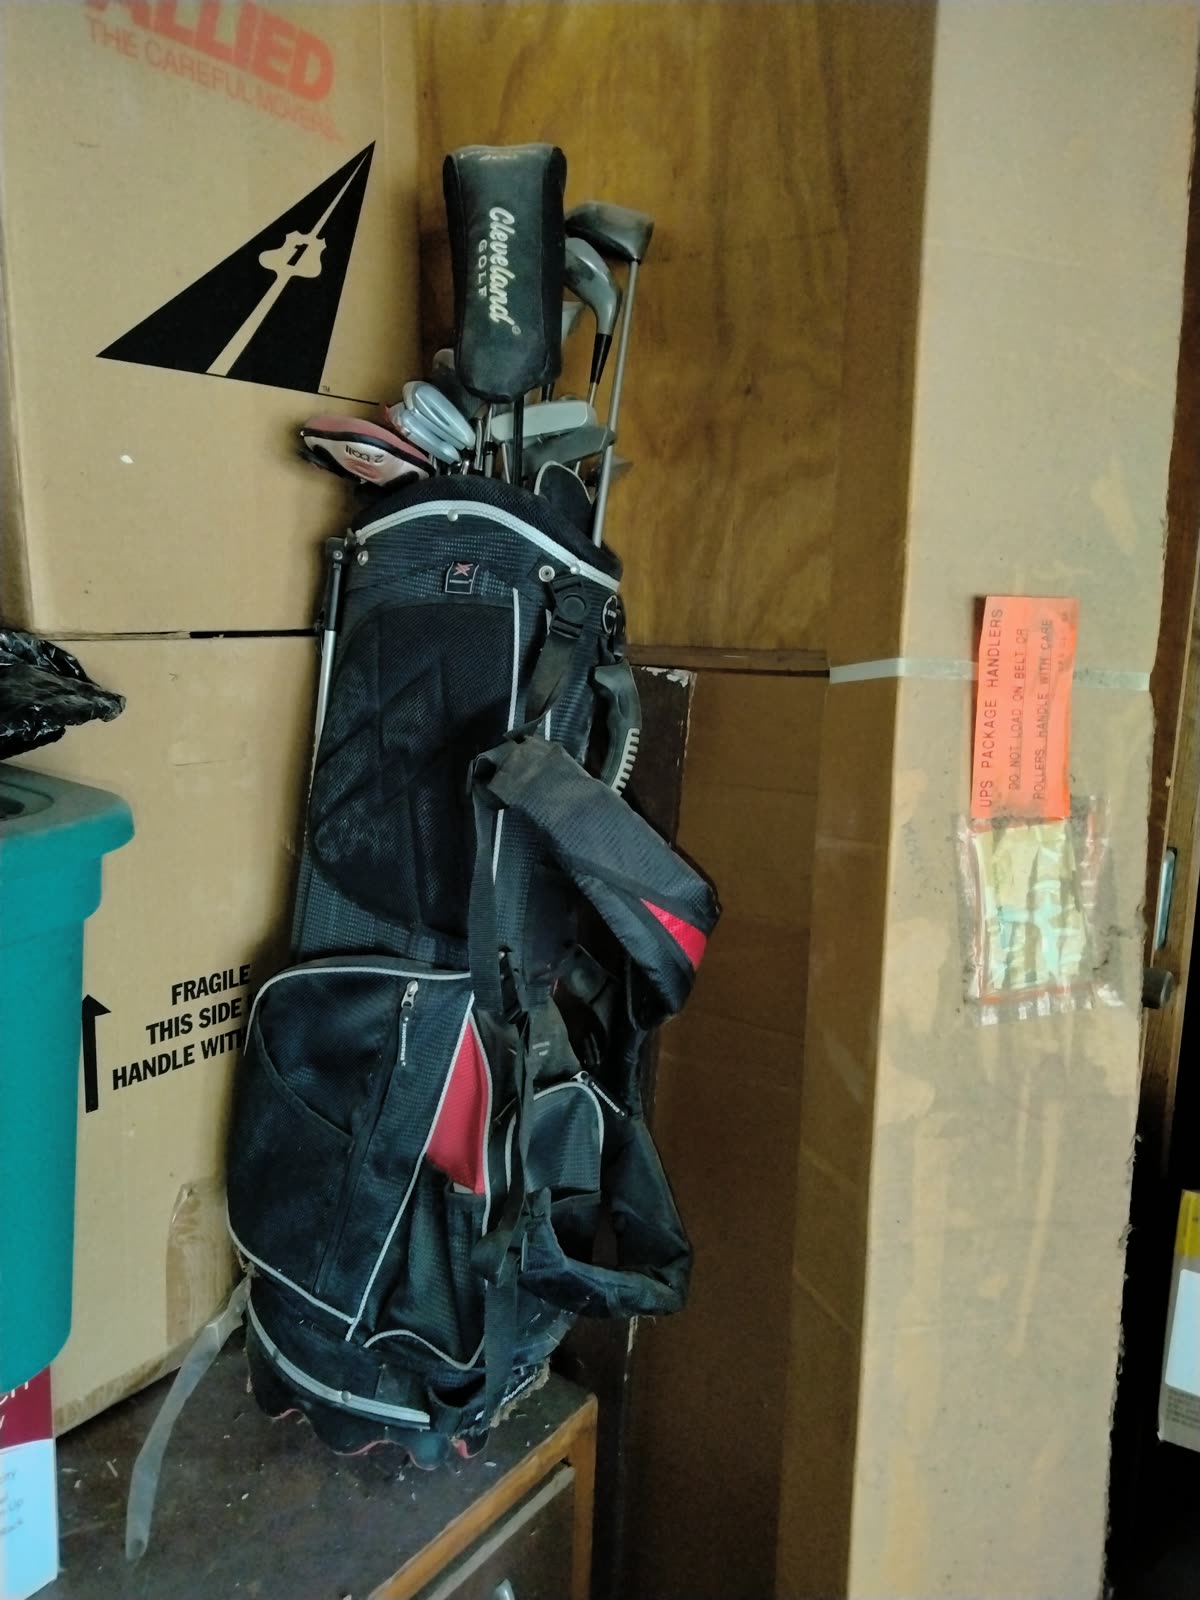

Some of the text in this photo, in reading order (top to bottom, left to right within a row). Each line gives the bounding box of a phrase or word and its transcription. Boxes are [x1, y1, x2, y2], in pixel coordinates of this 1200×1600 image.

[84, 0, 335, 101] LLIED
[86, 16, 138, 59] THE
[144, 39, 254, 106] CAREFUL
[287, 243, 309, 267] 1
[478, 239, 488, 298] GOLF
[488, 206, 516, 326] Cleveland
[1041, 618, 1052, 650] CARE
[1038, 657, 1049, 685] WITH
[979, 608, 1003, 808] UPS PACKAGE HANDLERS
[1008, 628, 1027, 791] DO NOT LOAD ON BELT OR
[1036, 693, 1049, 739] HANDLE
[171, 963, 251, 1006] FRAGILE
[146, 1013, 193, 1045] THIS
[199, 997, 242, 1029] SIDE
[112, 1028, 247, 1091] HANDLE WITH
